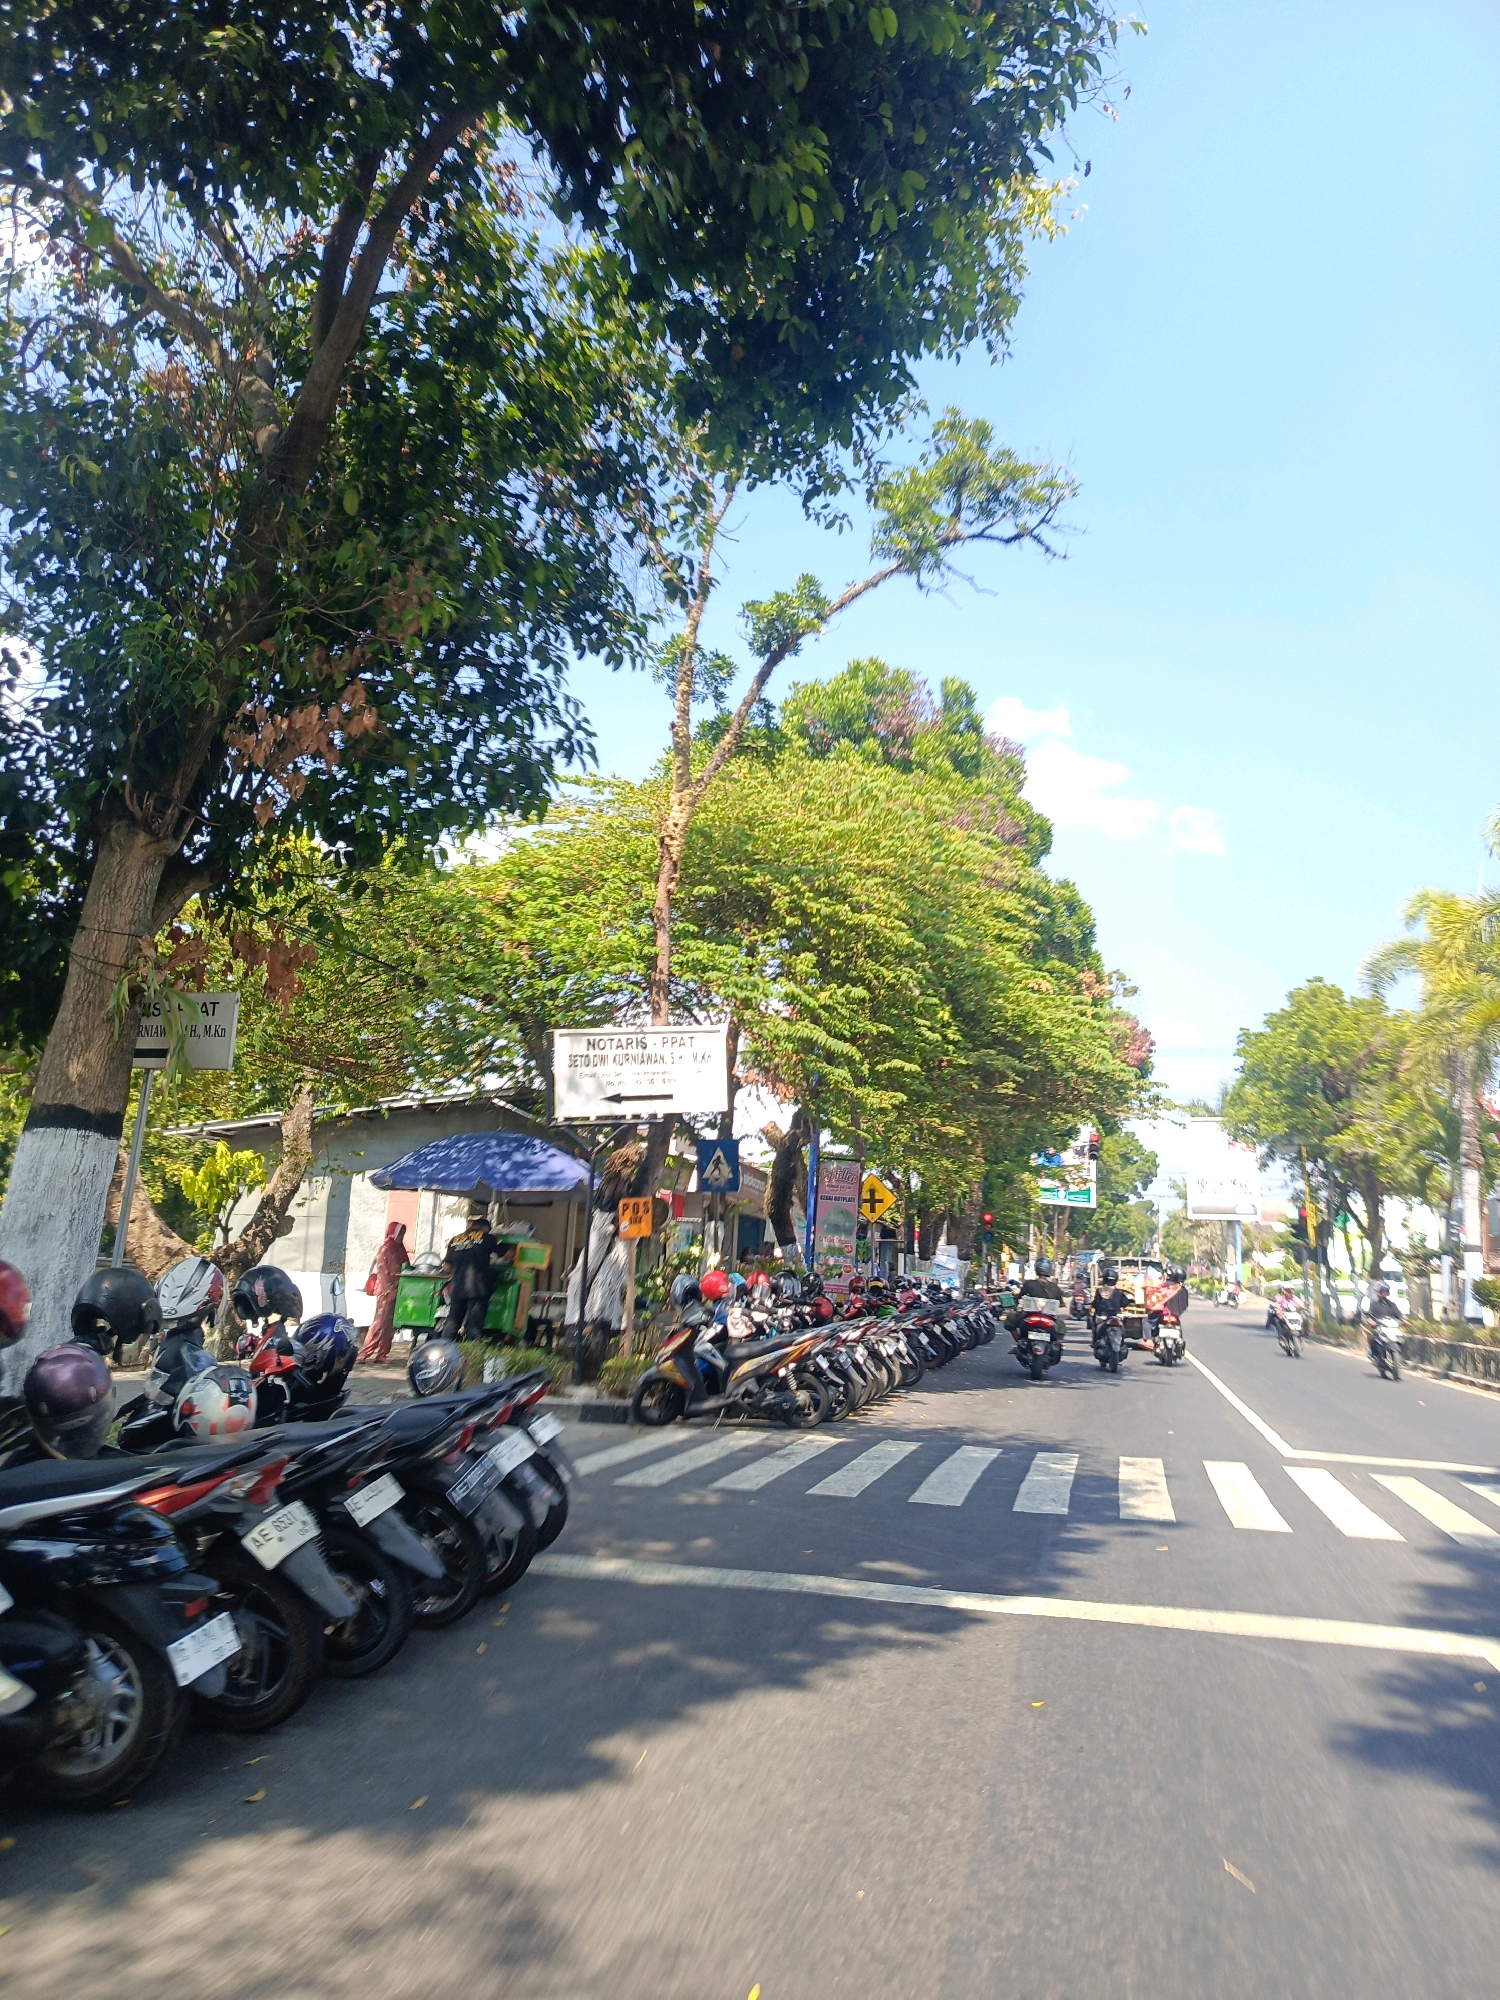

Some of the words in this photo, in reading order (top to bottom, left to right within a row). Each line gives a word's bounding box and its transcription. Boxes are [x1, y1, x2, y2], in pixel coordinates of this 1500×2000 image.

[203, 1025, 226, 1038] M.Kn
[586, 1036, 648, 1051] NOTARIS
[661, 1036, 695, 1048] PPAT
[567, 1053, 591, 1068] SETO
[592, 1053, 609, 1068] DWI
[621, 1201, 650, 1217] POS
[250, 1527, 275, 1551] AE
